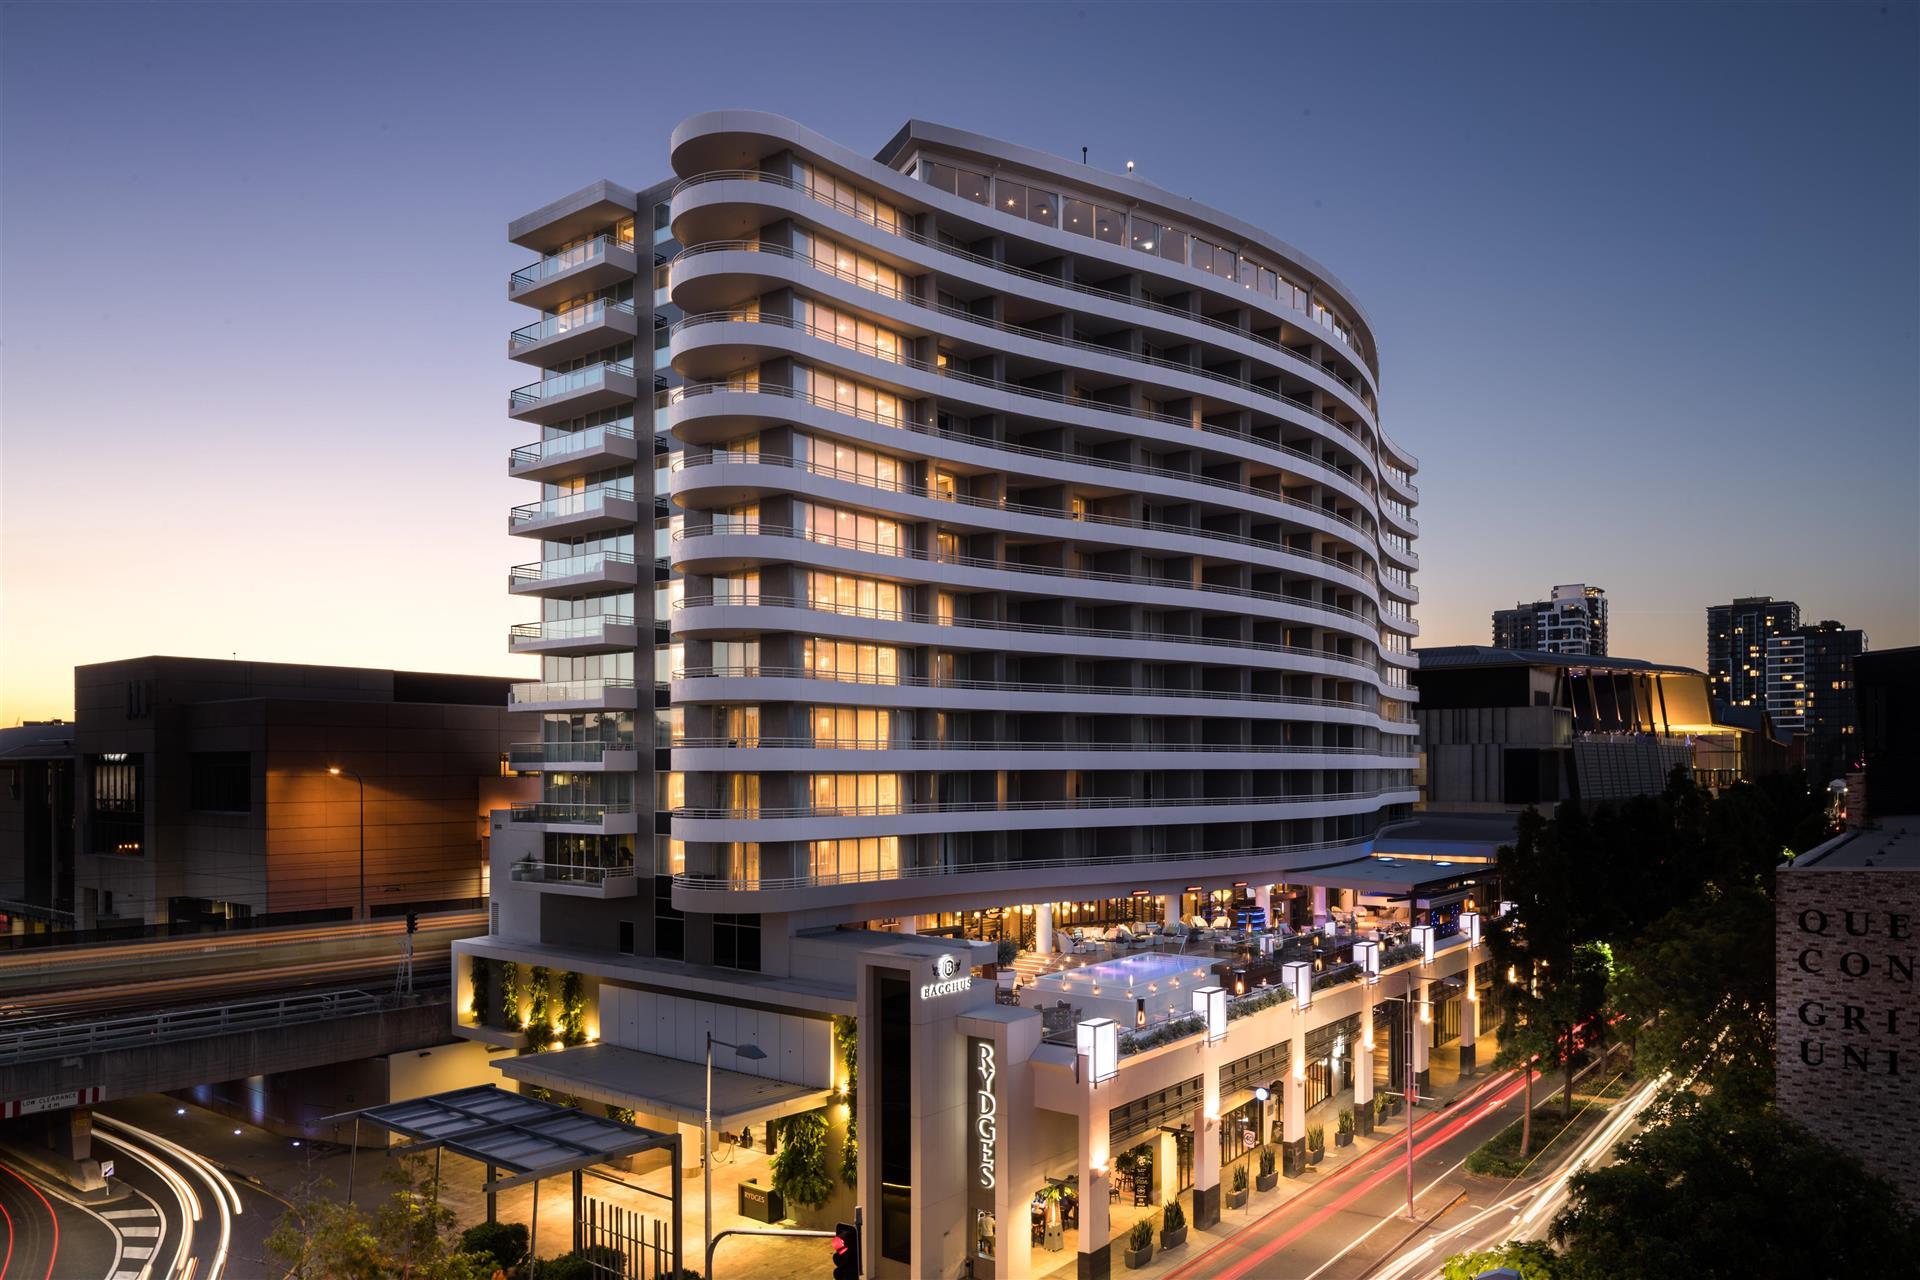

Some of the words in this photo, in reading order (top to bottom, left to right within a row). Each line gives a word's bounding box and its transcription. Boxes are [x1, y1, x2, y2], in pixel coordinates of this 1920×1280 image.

[1798, 909, 1912, 939] QUE
[1798, 949, 1916, 982] CON
[923, 978, 973, 998] BACCHUS
[1798, 1001, 1920, 1036] GRI
[1799, 1038, 1900, 1075] UNI
[38, 1092, 77, 1104] CLEARANCE
[977, 1043, 996, 1189] RYDGES
[744, 1191, 765, 1203] RYDGES
